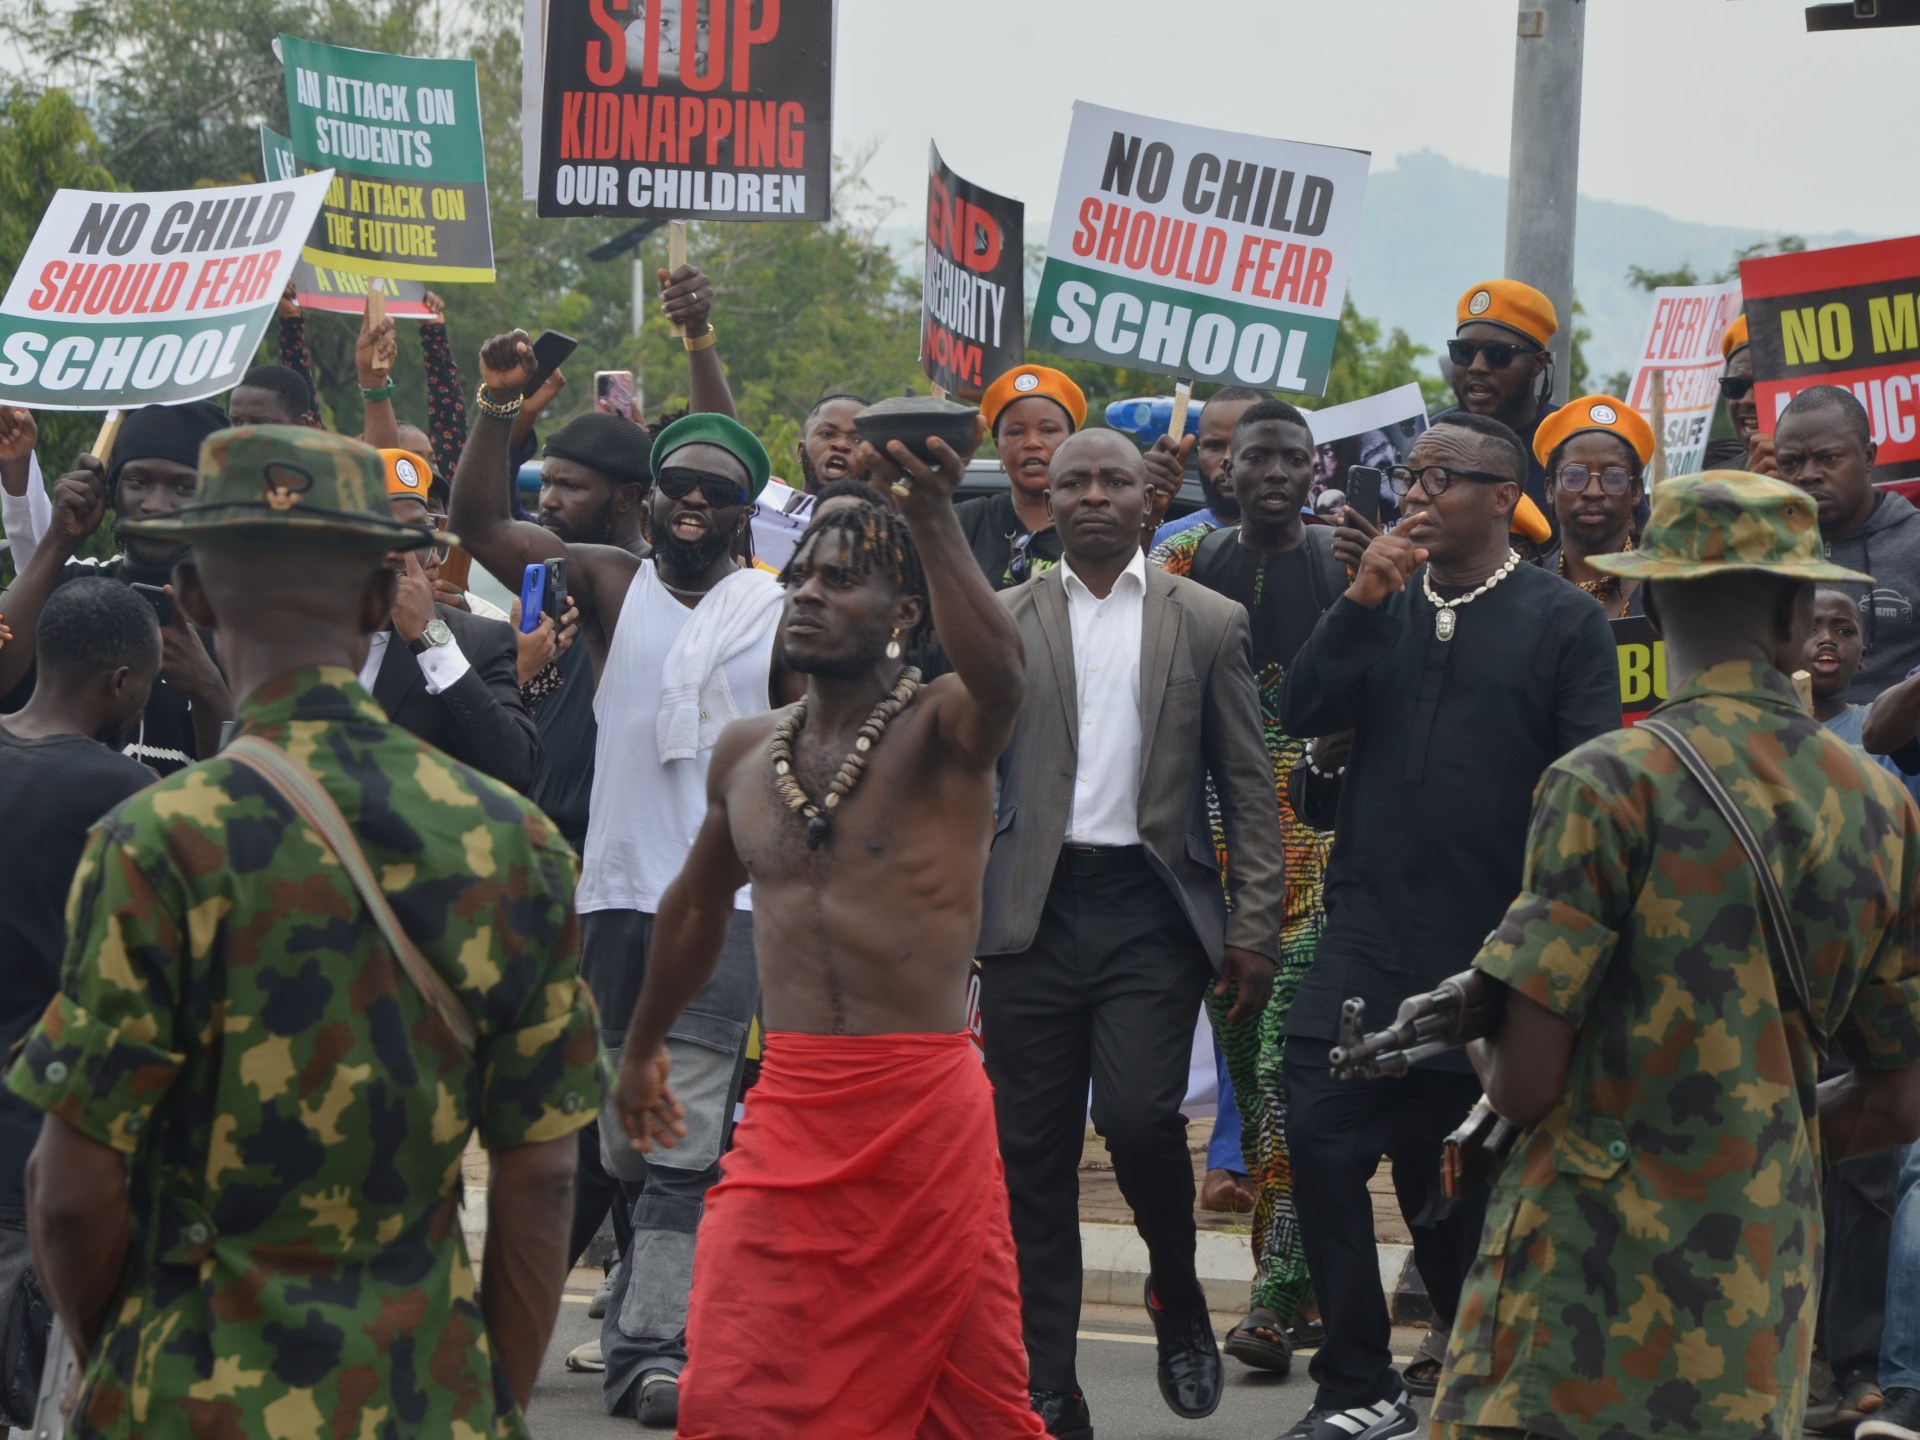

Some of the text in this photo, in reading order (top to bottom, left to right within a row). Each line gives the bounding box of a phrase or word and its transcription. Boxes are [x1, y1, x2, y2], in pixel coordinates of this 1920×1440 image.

[586, 0, 780, 92] STOP
[297, 67, 455, 126] AN ATTACK ON
[560, 91, 805, 168] KIDNAPPING
[275, 147, 296, 180] LE
[316, 116, 432, 168] STUDENTS
[324, 177, 466, 221] AN ATTACK ON
[556, 165, 805, 214] OUR CHILDREN
[1100, 131, 1334, 237] NO CHILD
[68, 191, 295, 257] NO CHILD
[325, 212, 437, 257] THE FUTURE
[928, 172, 1001, 273] END
[1072, 196, 1333, 307] SHOULD FEAR
[28, 249, 282, 315] SHOULD FEAR
[0, 324, 247, 391] SCHOOL
[926, 318, 984, 386] NOW!
[1050, 280, 1308, 391] SCHOOL
[1645, 296, 1715, 360] EVERY
[1780, 302, 1853, 366] NO
[1868, 292, 1920, 354] M
[1664, 416, 1706, 449] SAFE
